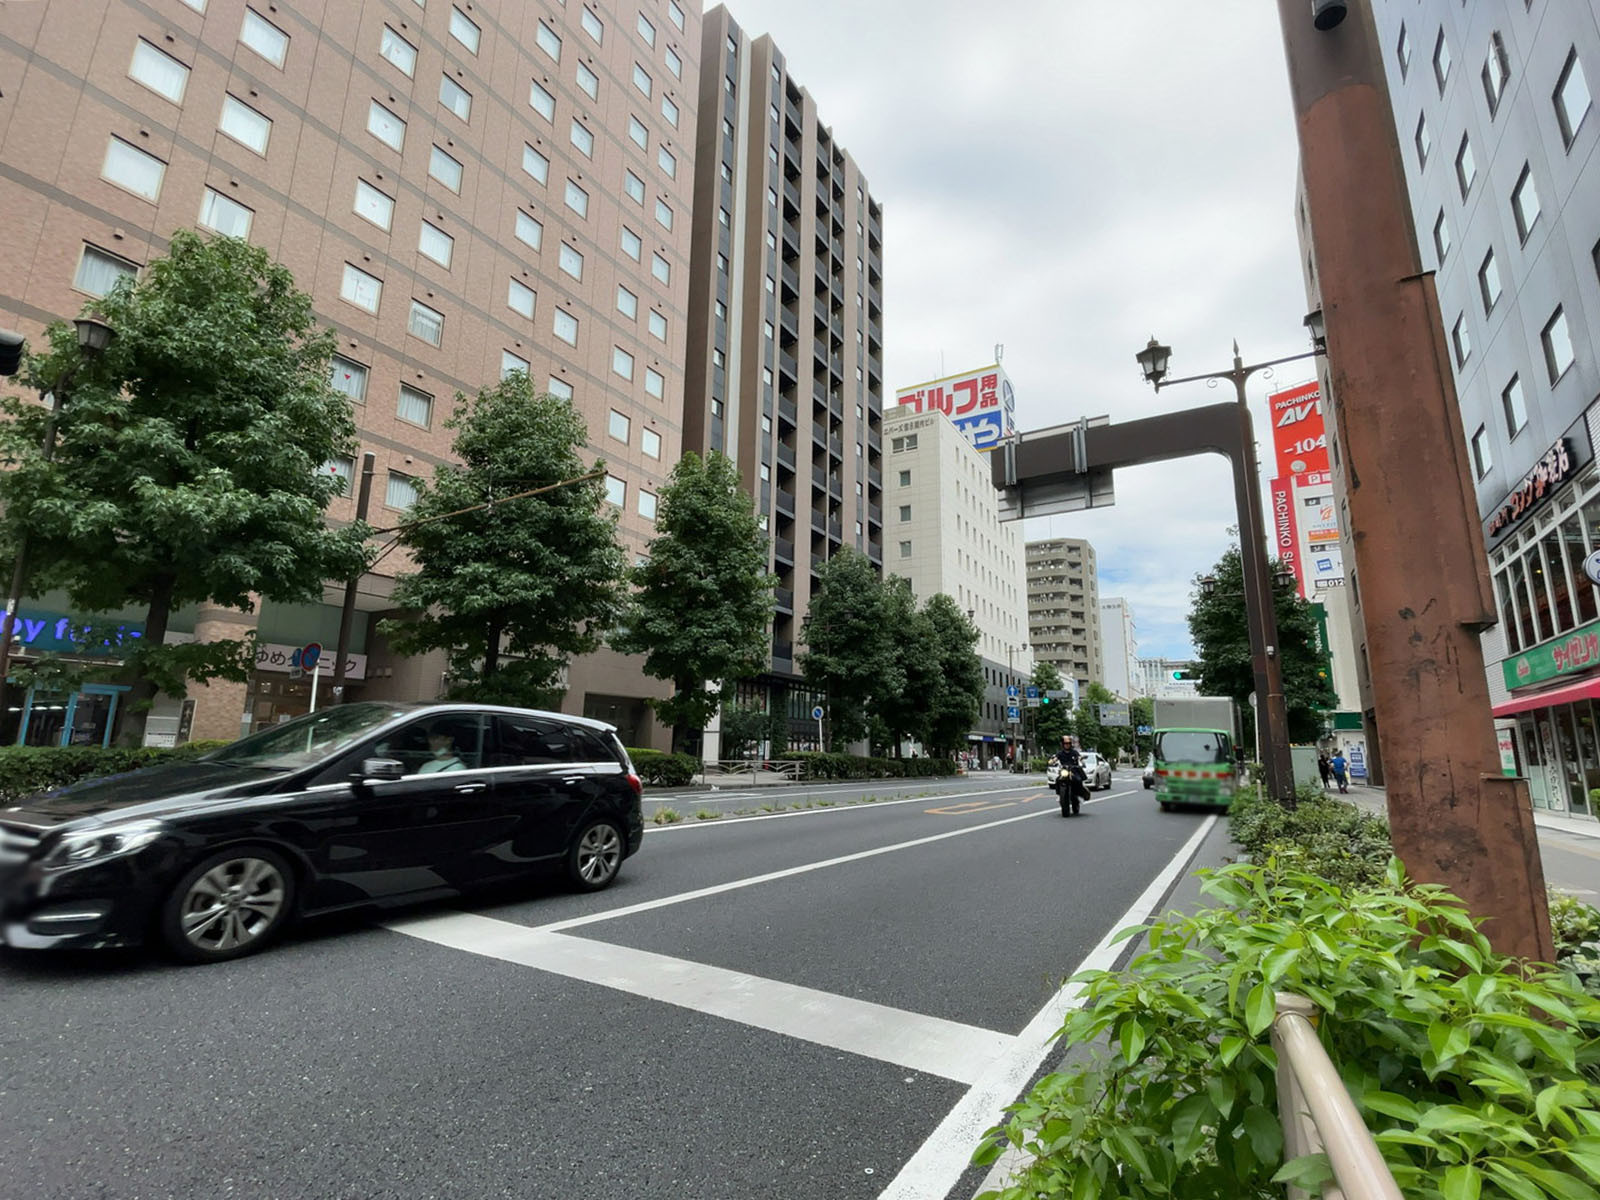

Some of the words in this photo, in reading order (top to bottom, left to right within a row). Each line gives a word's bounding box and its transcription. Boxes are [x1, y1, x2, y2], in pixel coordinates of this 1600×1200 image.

[898, 378, 978, 416] ゴルフ
[980, 373, 998, 408] 用品
[956, 418, 1000, 445] や
[1276, 491, 1292, 547] PACHINKO
[1553, 633, 1599, 671] サイゼリヤ
